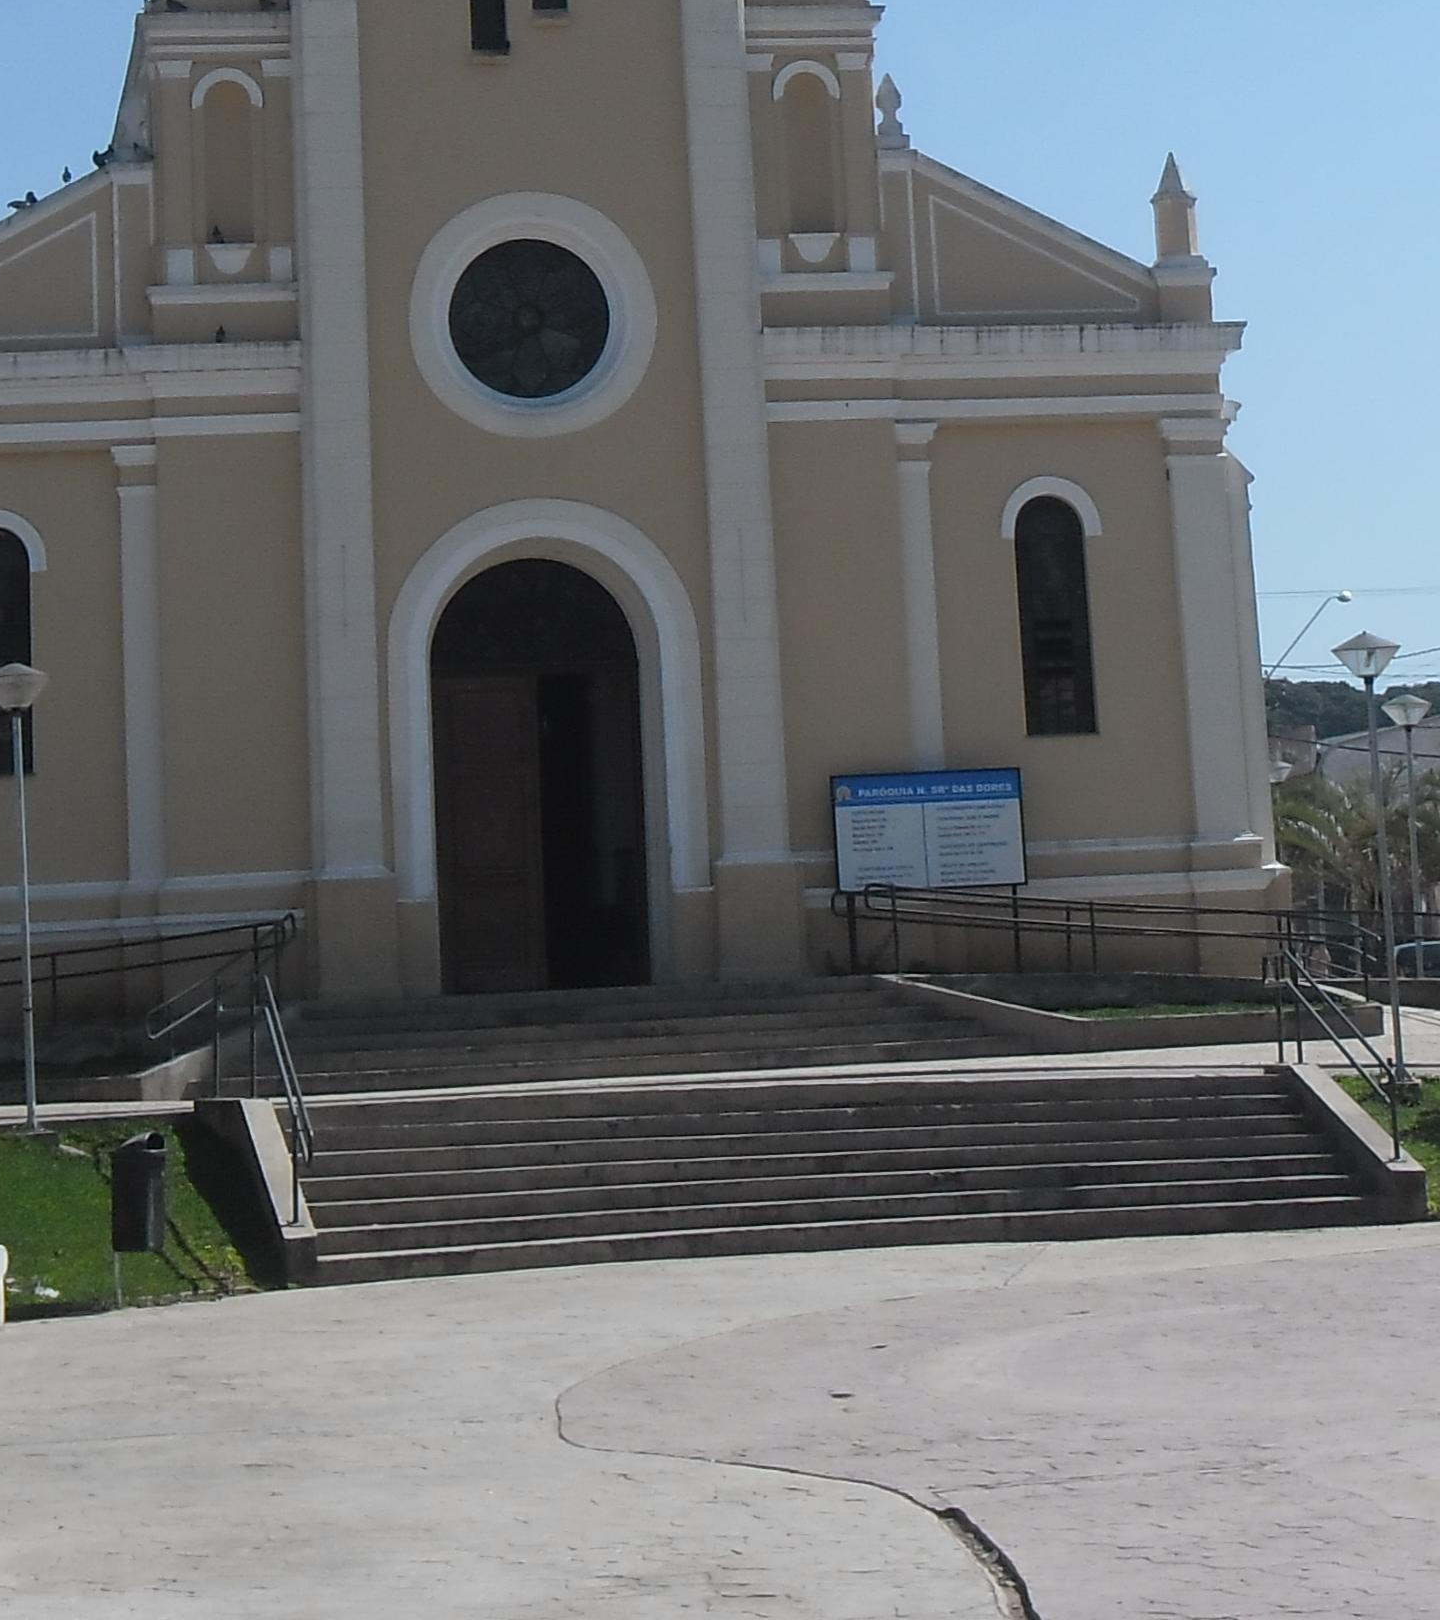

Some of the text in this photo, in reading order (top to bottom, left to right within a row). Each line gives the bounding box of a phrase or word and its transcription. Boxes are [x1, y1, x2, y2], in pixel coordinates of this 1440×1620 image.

[858, 784, 914, 798] PARÓQUIA
[952, 785, 974, 794] DAS
[976, 783, 1013, 793] DORES
